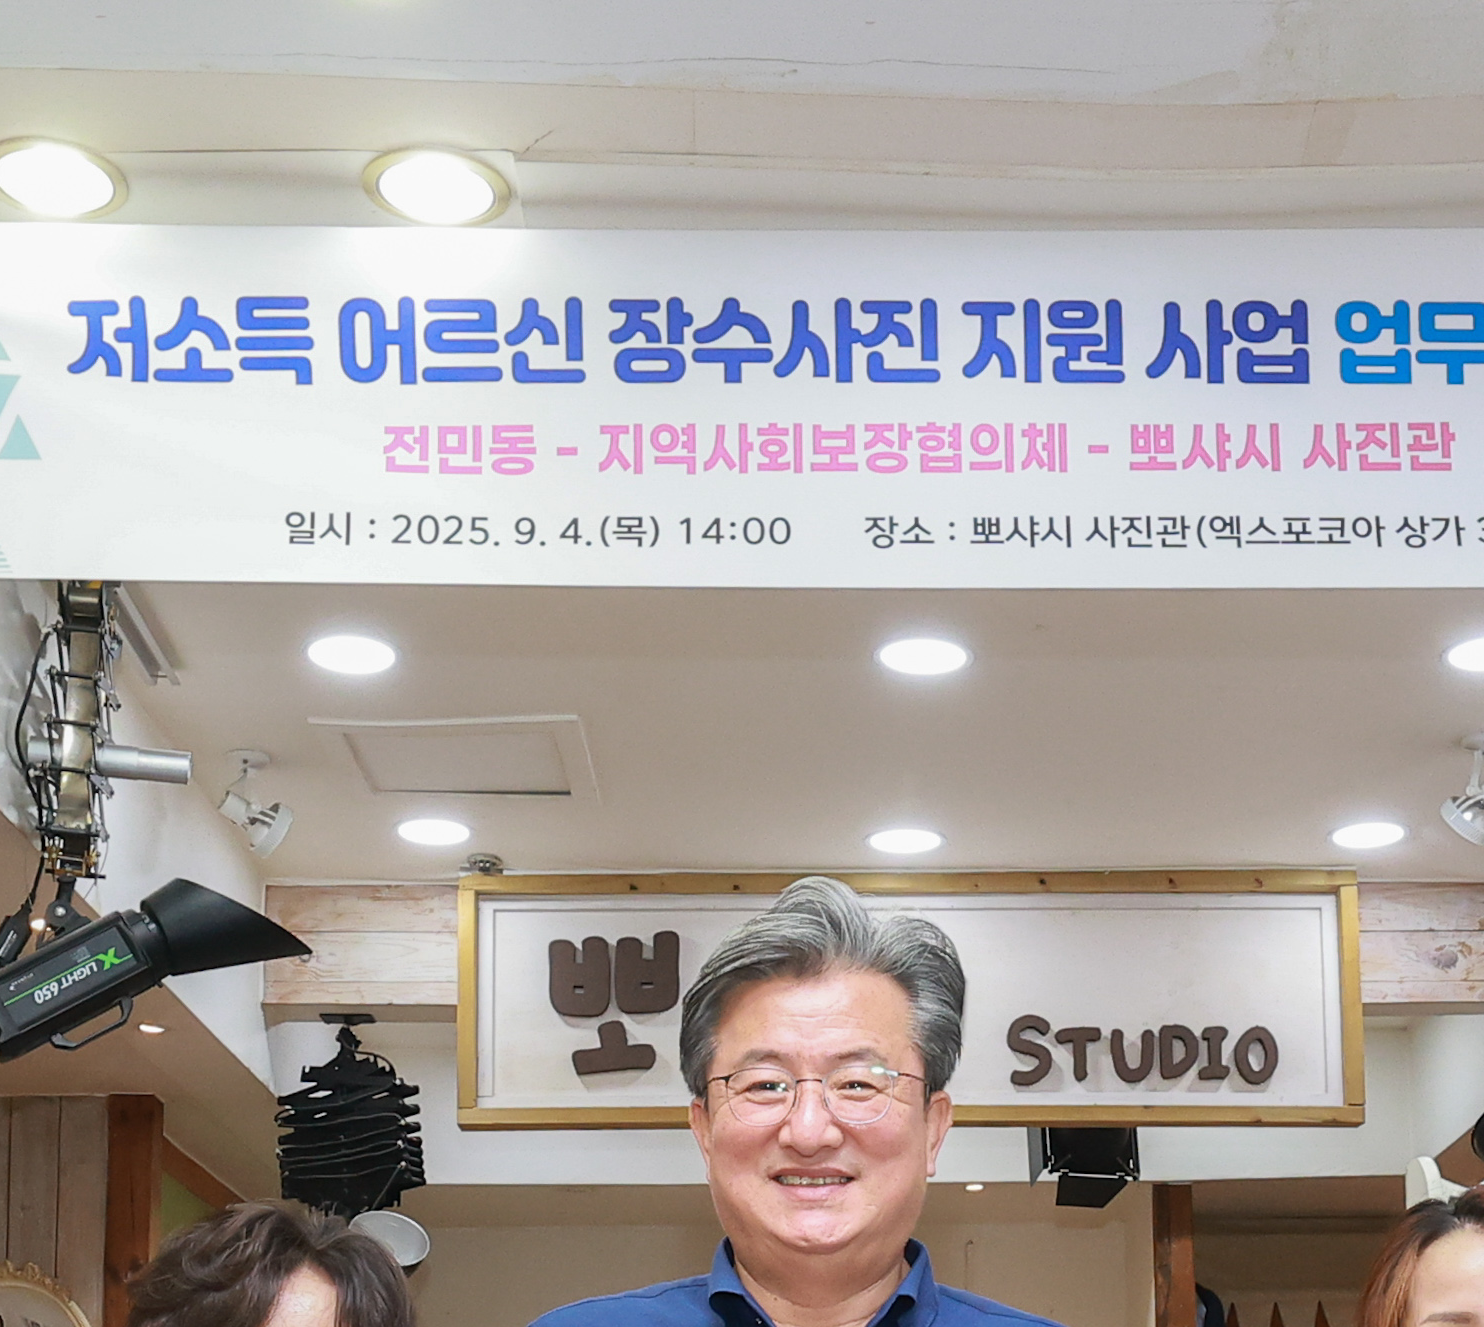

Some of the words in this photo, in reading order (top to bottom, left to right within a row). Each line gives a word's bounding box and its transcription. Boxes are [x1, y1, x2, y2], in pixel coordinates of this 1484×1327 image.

[66, 295, 315, 386] 저소득
[337, 295, 587, 386] 어르신
[608, 295, 941, 385] 장수사진
[961, 296, 1127, 385] 지원
[1145, 297, 1312, 385] 사업
[382, 423, 537, 476] 전민동
[598, 422, 1069, 477] 지역사회보장협의체
[1129, 422, 1281, 475] 뽀샤시
[1302, 421, 1456, 475] 사진관
[284, 511, 353, 548] 일시
[390, 514, 502, 548] 2025.
[513, 515, 548, 548] 9.
[559, 511, 661, 551] 4.(목)
[679, 515, 793, 546] 14:00
[864, 514, 935, 549] 장소
[971, 515, 1073, 548] 뽀샤시
[1084, 513, 1386, 551] 사진관(엑스포코아
[1395, 515, 1465, 548] 상가
[34, 981, 59, 1004] 650
[61, 961, 98, 990] LIGHT
[1006, 1014, 1279, 1086] STUDIO
